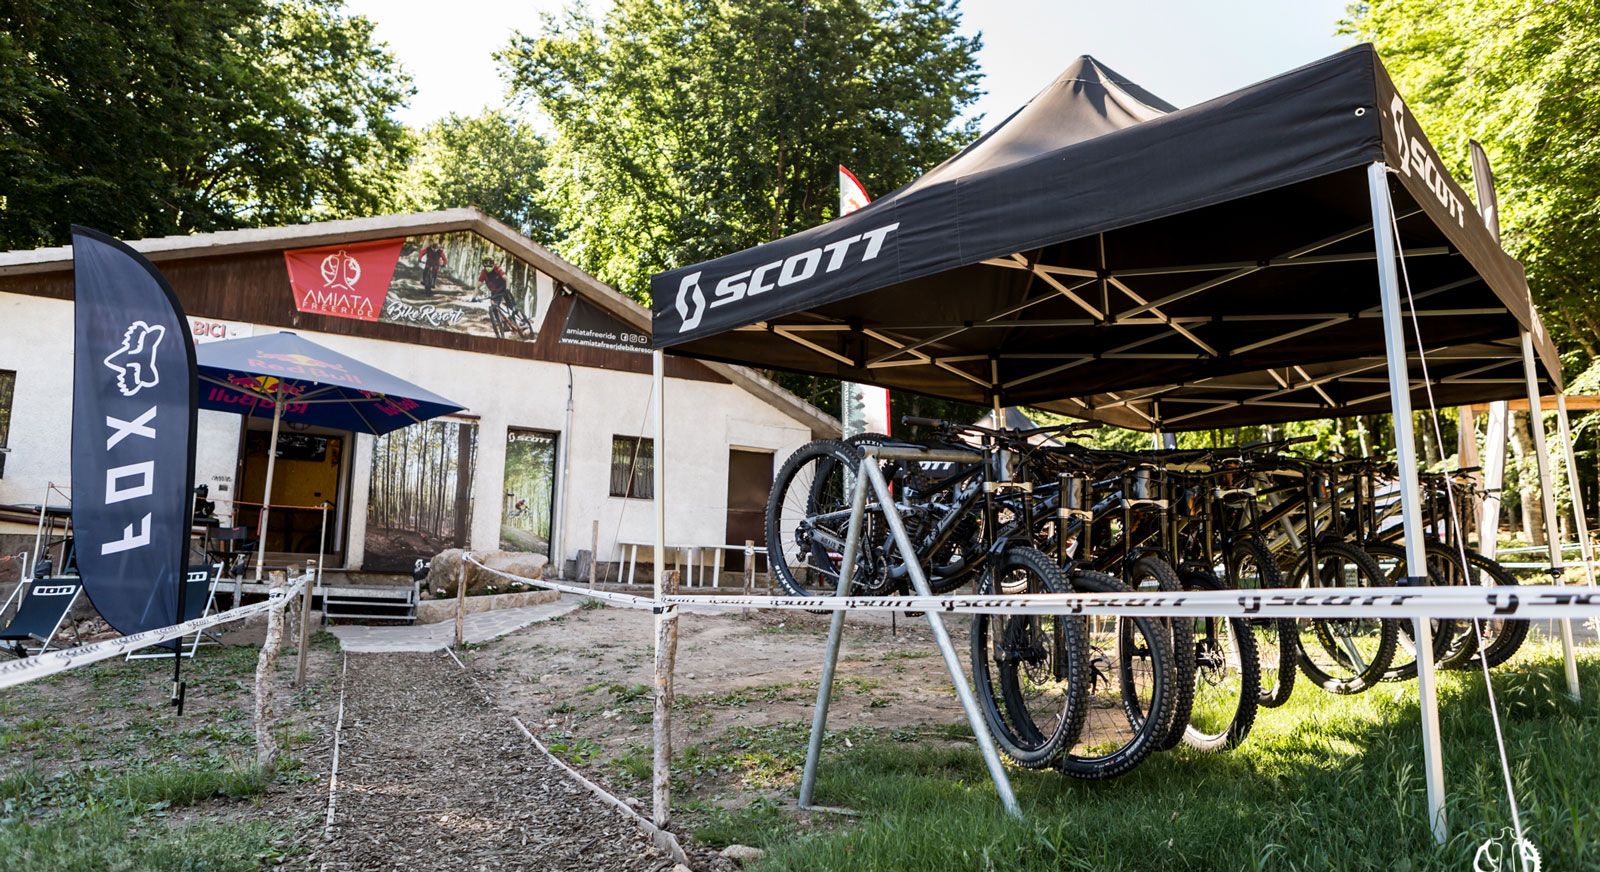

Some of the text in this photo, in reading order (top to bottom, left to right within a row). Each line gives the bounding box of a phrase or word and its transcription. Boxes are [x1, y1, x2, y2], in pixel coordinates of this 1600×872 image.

[1410, 136, 1464, 229] SCOTT
[709, 221, 900, 309] SCOTT
[302, 302, 373, 317] FREERIDE
[303, 289, 374, 312] AMIATA
[386, 301, 465, 327] Bike Resort
[193, 321, 227, 338] BICI
[566, 328, 617, 340] amiatafreeride
[101, 405, 157, 556] FOX
